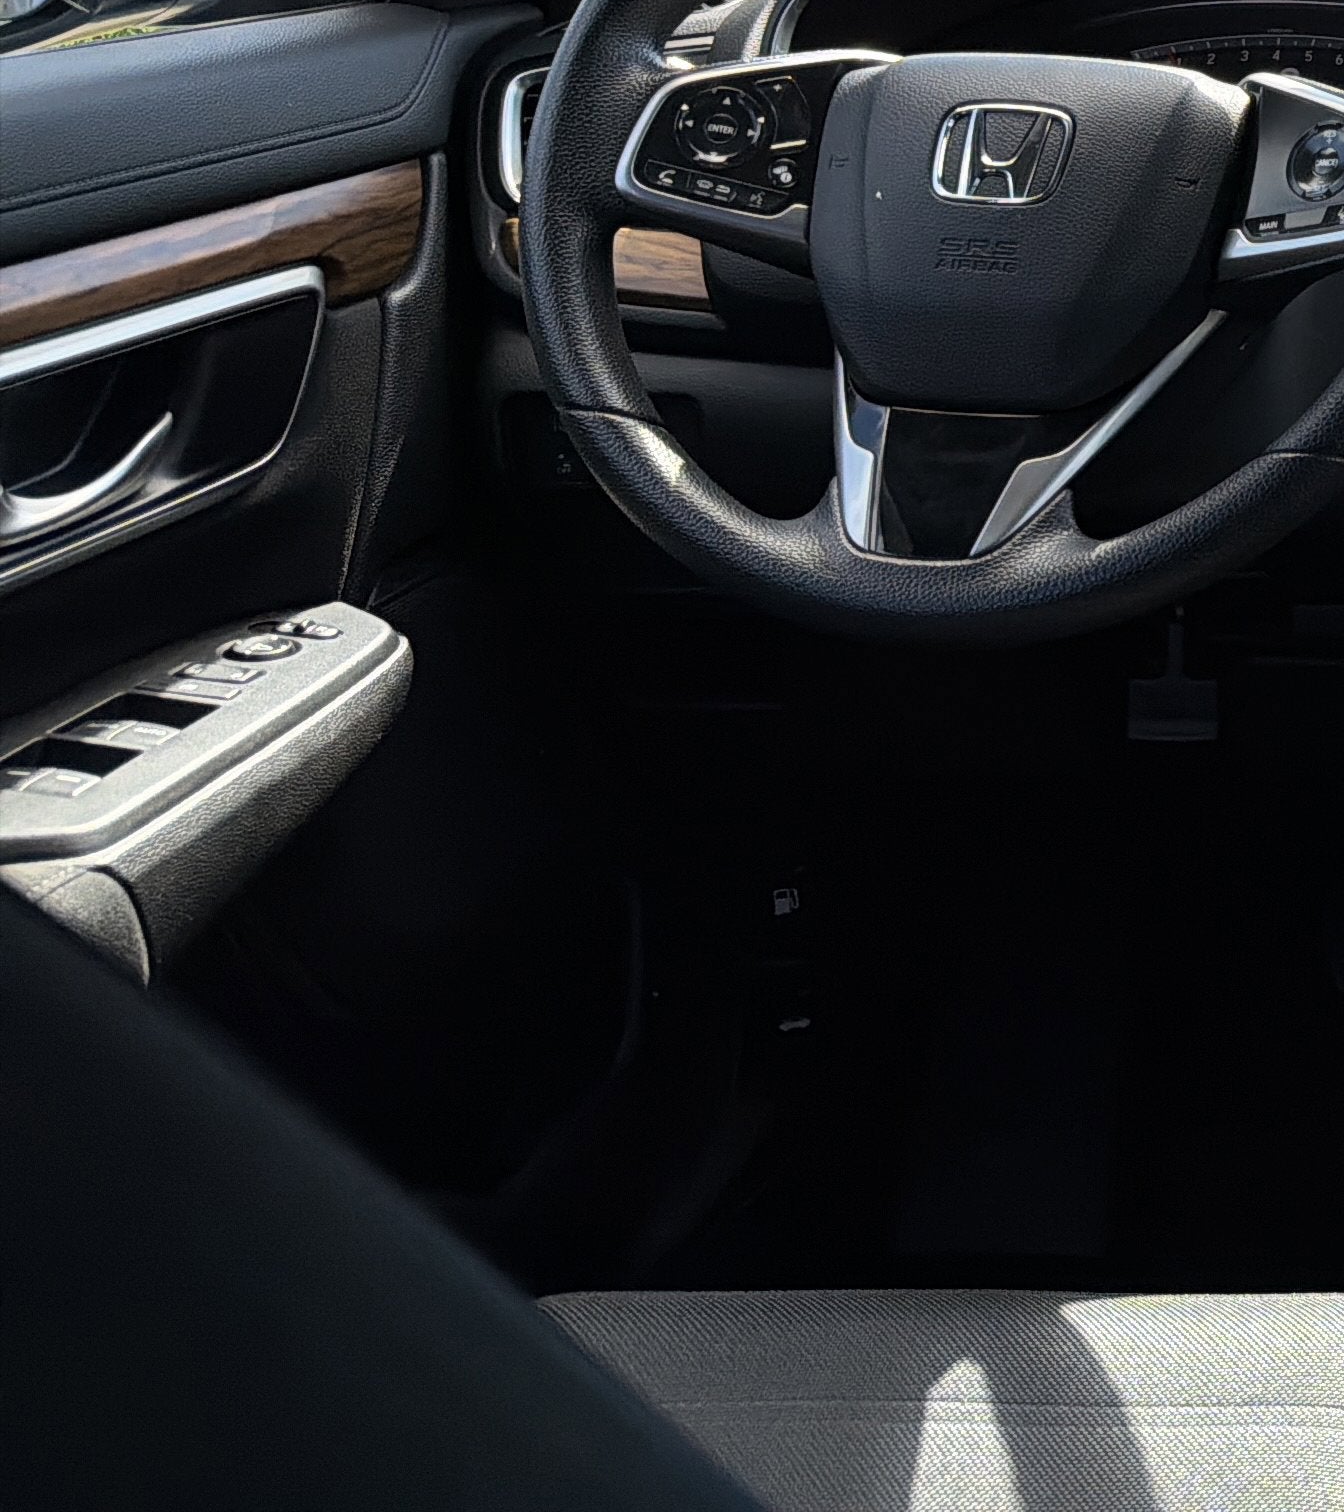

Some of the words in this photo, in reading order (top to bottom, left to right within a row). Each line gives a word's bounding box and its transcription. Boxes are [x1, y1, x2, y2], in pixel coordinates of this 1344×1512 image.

[1206, 53, 1216, 65] 2
[1240, 50, 1249, 62] 3
[1272, 49, 1281, 61] 4
[1304, 50, 1313, 62] 5
[1335, 53, 1344, 66] 6
[707, 123, 735, 135] ENTER
[1259, 221, 1279, 231] MAIN
[937, 236, 1020, 257] SRS
[934, 257, 1019, 276] AIRBAG
